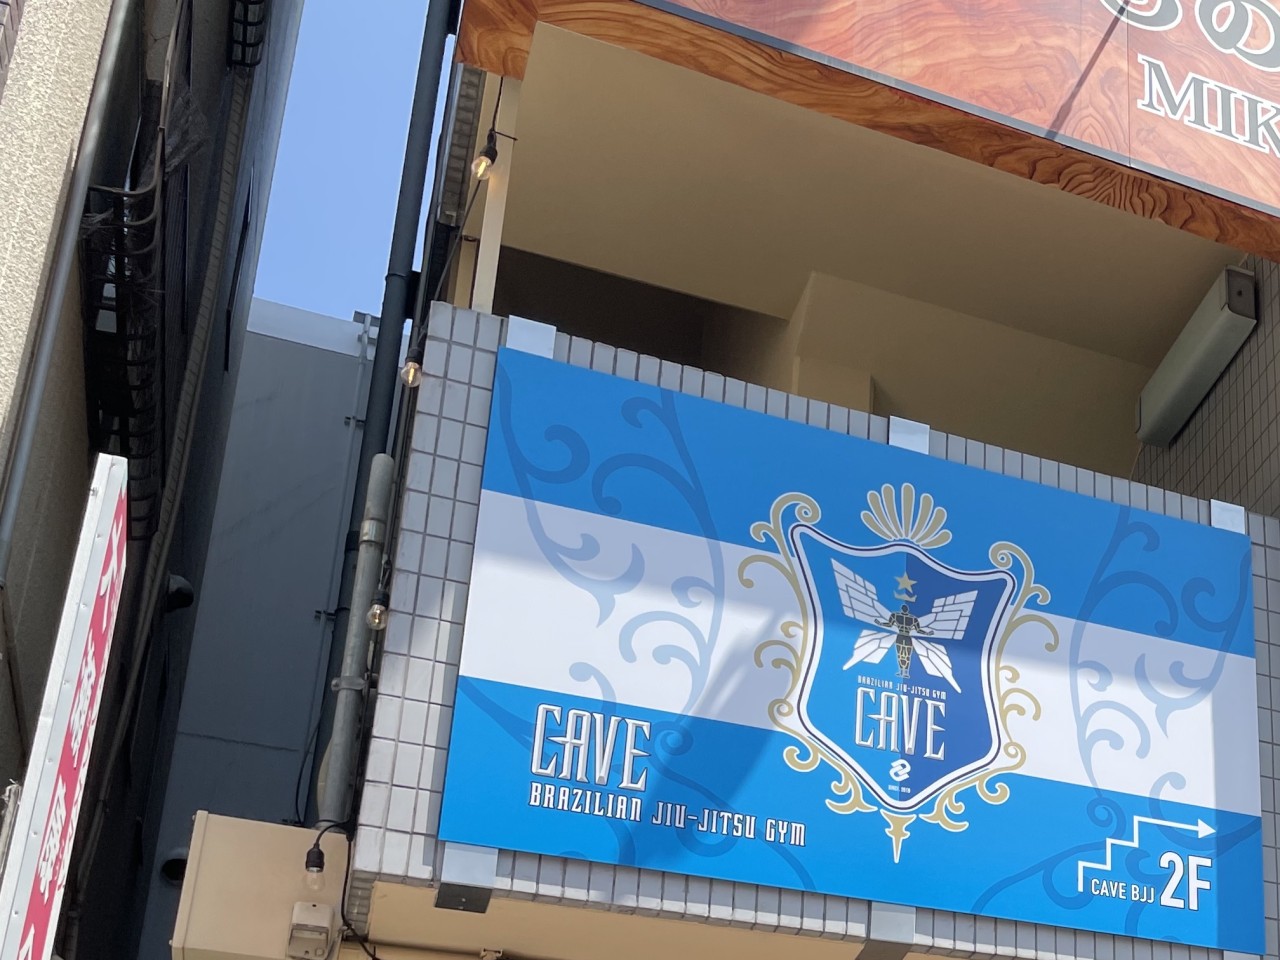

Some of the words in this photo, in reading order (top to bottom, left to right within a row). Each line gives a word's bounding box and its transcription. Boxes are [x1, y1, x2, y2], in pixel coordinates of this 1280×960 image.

[857, 675, 893, 690] BRAZILIAN
[895, 683, 930, 697] JIU-JITSU
[932, 689, 947, 700] GYM
[531, 703, 651, 792] CAVE
[855, 686, 946, 761] CAVE
[529, 782, 643, 823] BRAZILIAN
[651, 801, 756, 839] JIU-JITSU
[764, 823, 806, 847] GYM
[1091, 878, 1127, 900] CAVE
[1131, 883, 1155, 904] BJJ
[1160, 852, 1213, 912] 2F
